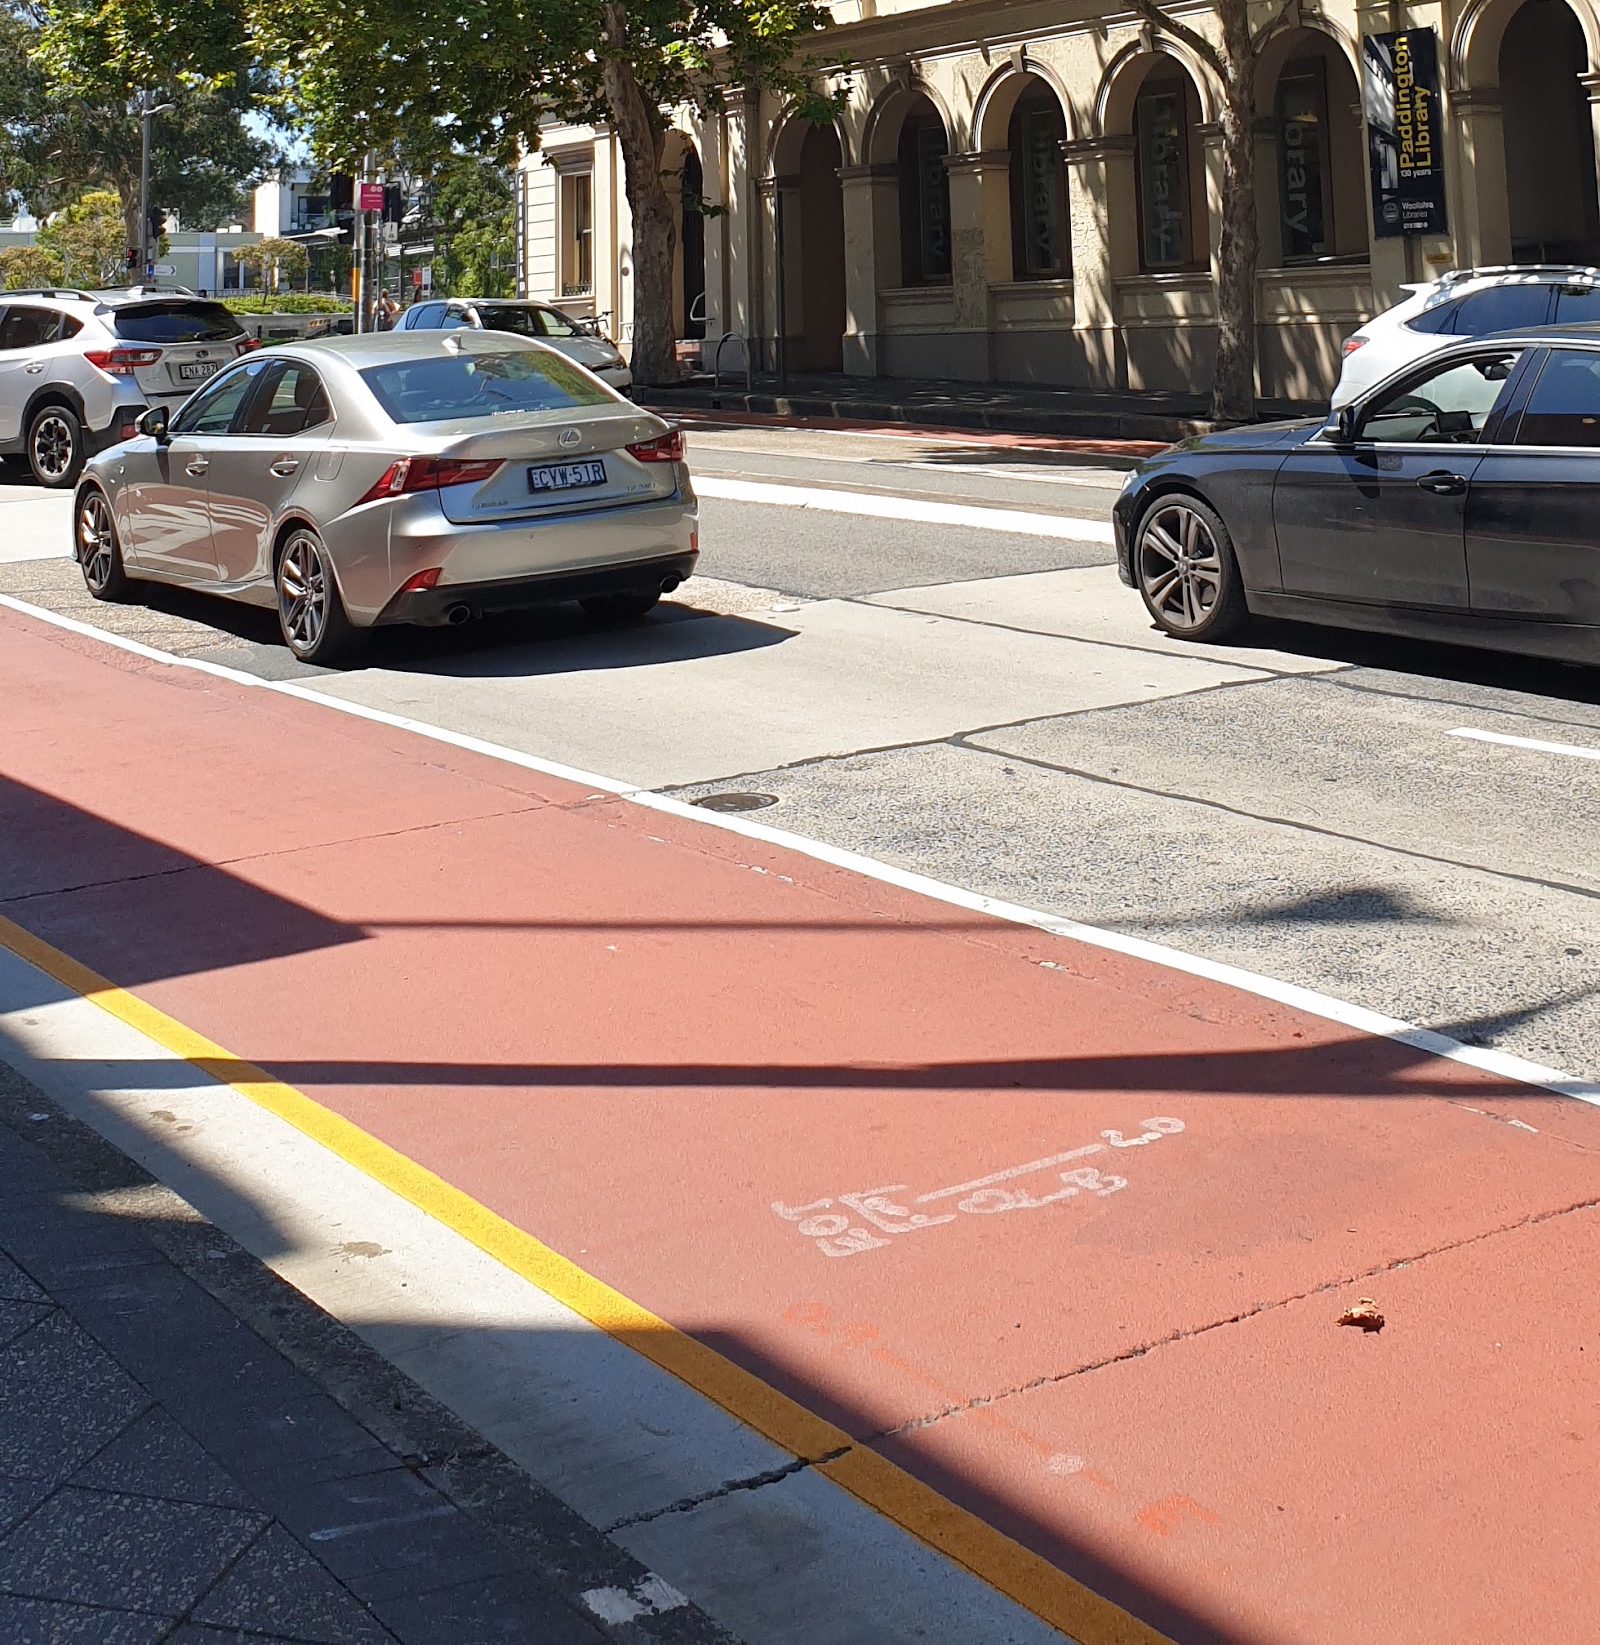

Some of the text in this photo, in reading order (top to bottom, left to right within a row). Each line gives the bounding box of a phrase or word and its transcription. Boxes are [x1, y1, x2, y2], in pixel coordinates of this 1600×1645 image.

[1394, 36, 1415, 169] Paddington
[1413, 86, 1432, 167] Library
[1412, 168, 1432, 179] years
